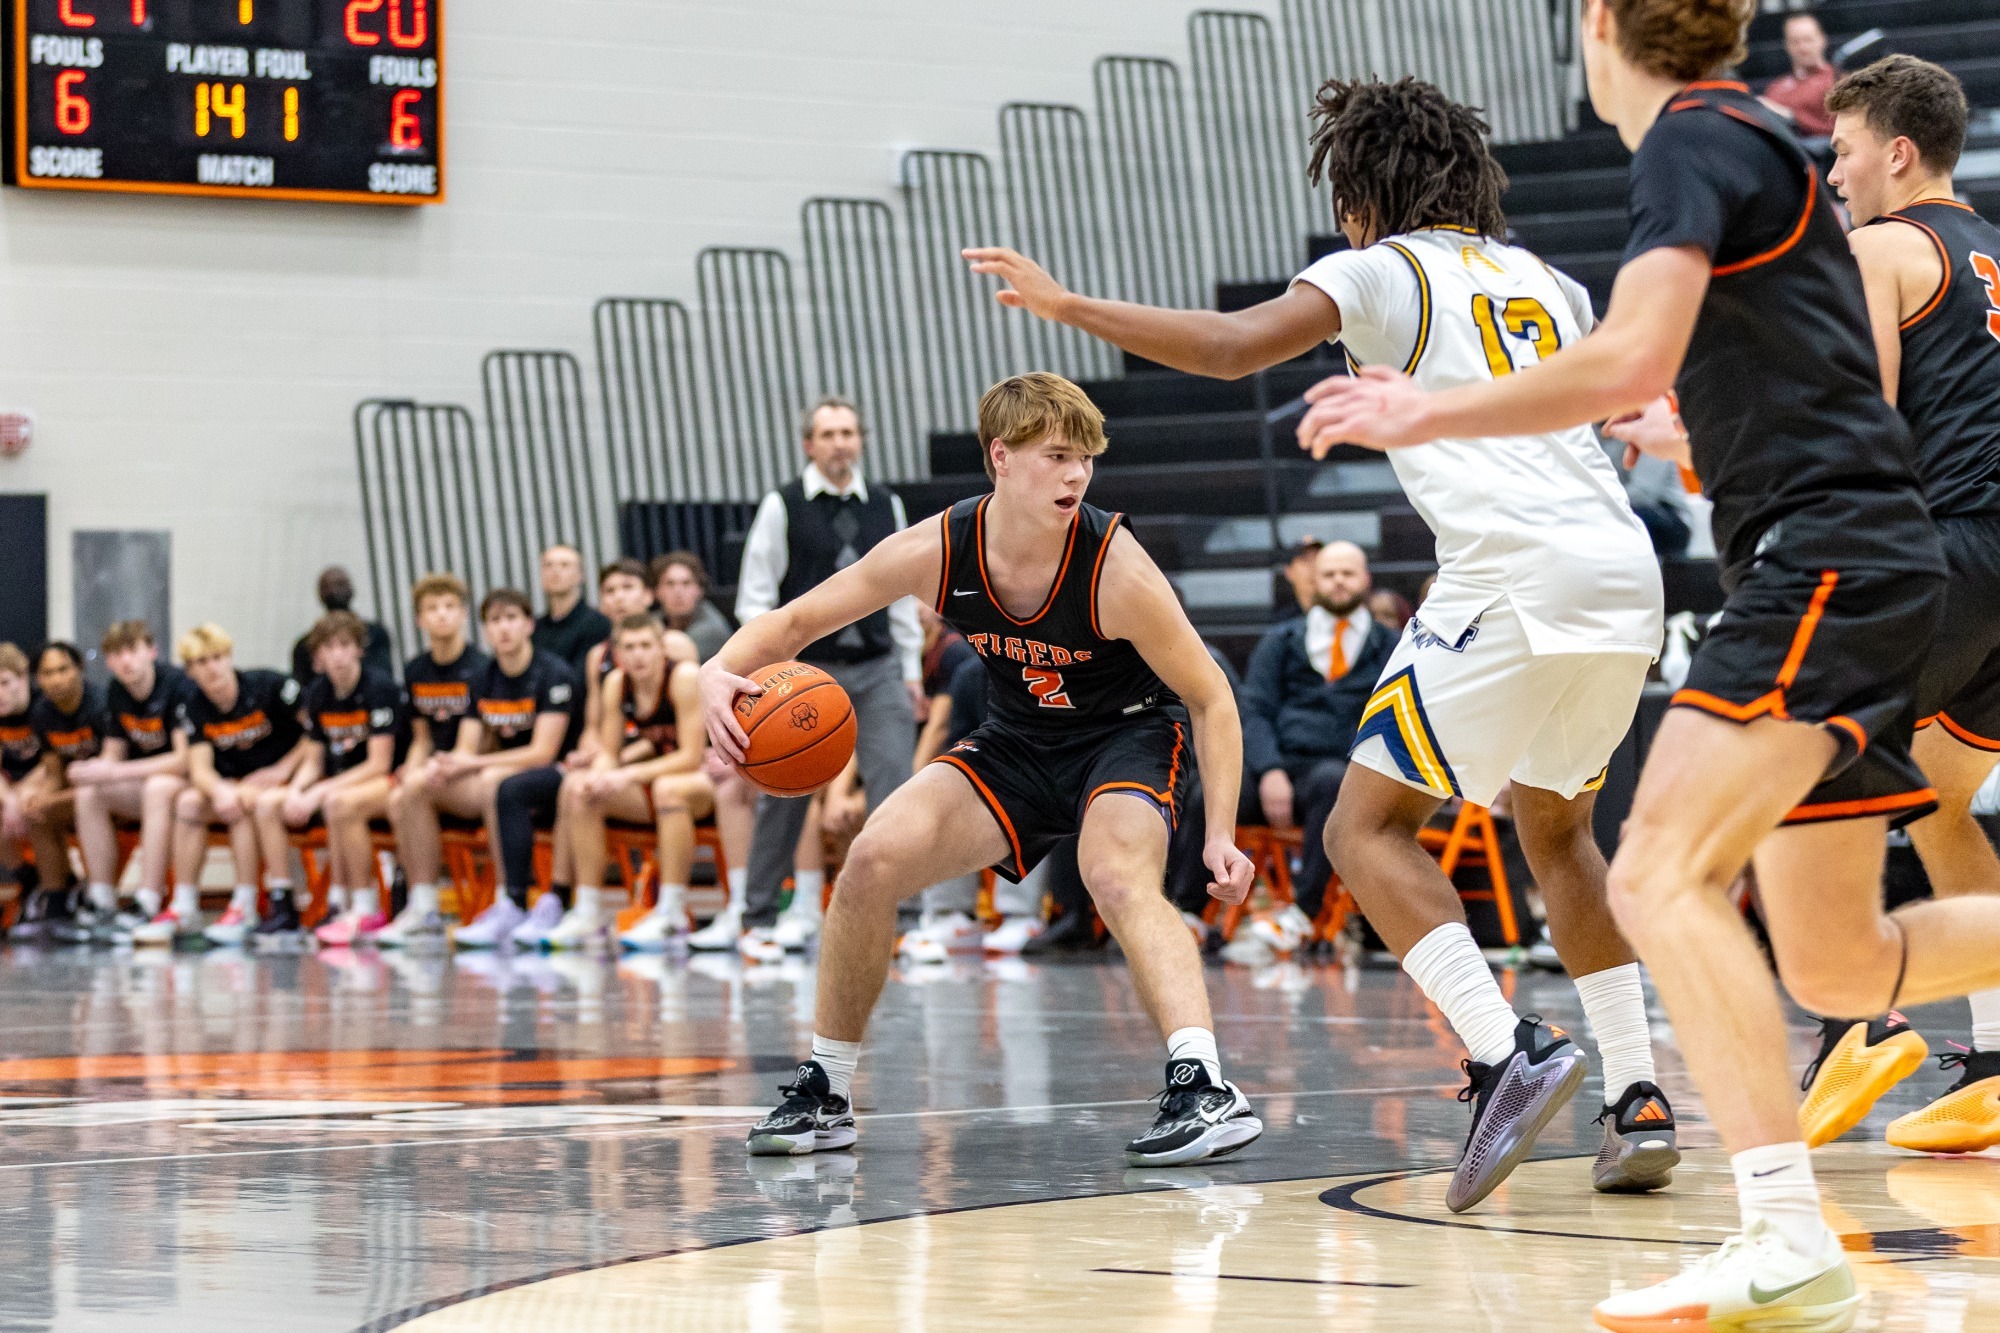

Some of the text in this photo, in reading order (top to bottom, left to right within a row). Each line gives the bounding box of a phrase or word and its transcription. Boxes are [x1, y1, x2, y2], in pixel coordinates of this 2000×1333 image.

[30, 34, 104, 68] FOULS
[166, 42, 312, 80] PLAYER FOUL
[369, 54, 437, 87] FOULS
[55, 69, 91, 135] 6
[195, 82, 299, 141] 14 1
[29, 146, 103, 178] SCORE
[198, 154, 274, 186] MATCH
[368, 163, 437, 194] SCORE
[967, 633, 1092, 666] TIGERS
[1022, 665, 1076, 709] 2
